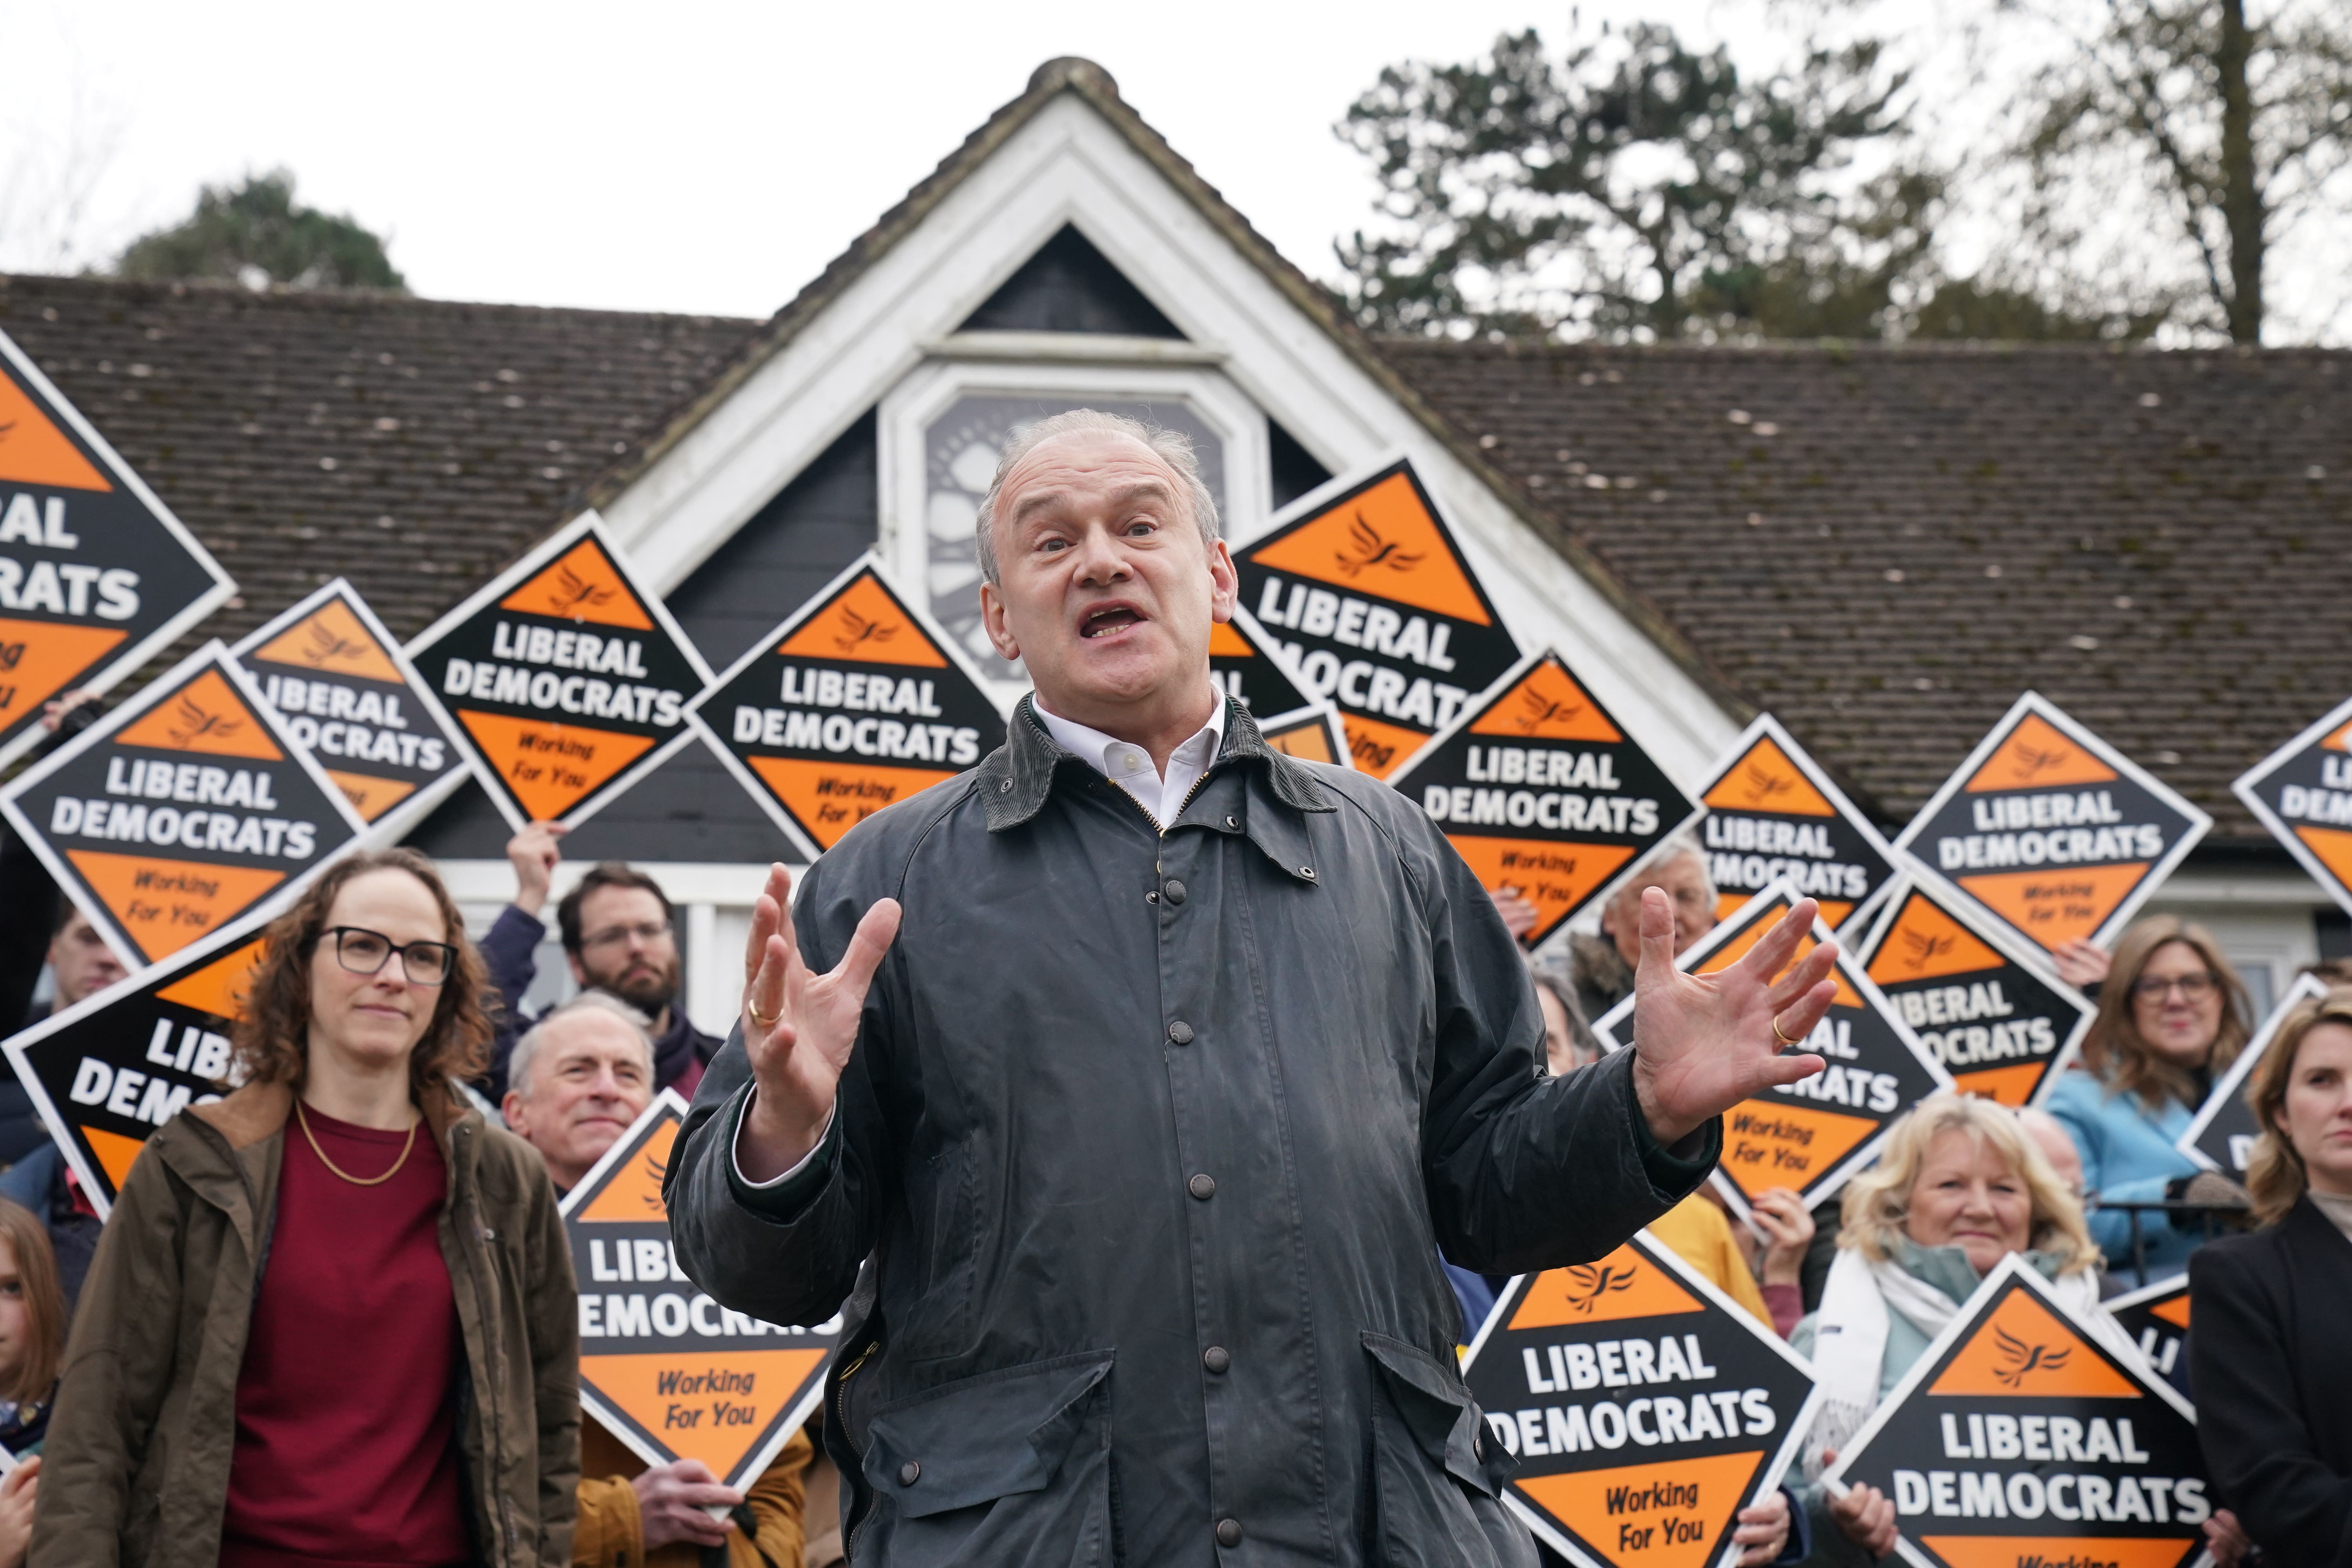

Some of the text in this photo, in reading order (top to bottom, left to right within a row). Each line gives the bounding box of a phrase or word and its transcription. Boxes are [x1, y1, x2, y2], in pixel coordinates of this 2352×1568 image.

[1256, 576, 1456, 673] LIBERAL
[492, 621, 647, 679] LIBERAL
[443, 659, 683, 727] DEMOCRATS
[780, 666, 942, 718] LIBERAL
[518, 730, 596, 760] Working
[733, 706, 980, 765] DEMOCRATS
[106, 757, 277, 811] LIBERAL
[511, 761, 587, 789] For You
[1466, 745, 1621, 789] LIBERAL
[817, 778, 896, 802] Working
[1423, 786, 1659, 835] DEMOCRATS
[1973, 790, 2122, 831] LIBERAL
[51, 797, 316, 859] DEMOCRATS
[817, 804, 848, 822] For
[1705, 814, 1836, 859] LIBERAL
[1938, 824, 2163, 870] DEMOCRATS
[134, 868, 220, 897] Working
[1501, 850, 1576, 874] Working
[126, 904, 211, 927] For You
[1732, 1115, 1815, 1145] Working
[1733, 1143, 1811, 1171] For You
[657, 1368, 755, 1396] Working
[1523, 1334, 1716, 1394] LIBERAL
[665, 1403, 755, 1430] For You
[1486, 1388, 1776, 1457] DEMOCRATS
[1940, 1413, 2149, 1464] LIBERAL
[1606, 1481, 1699, 1515] Working
[1892, 1469, 2211, 1524] DEMOCRATS
[1619, 1517, 1704, 1553] For You
